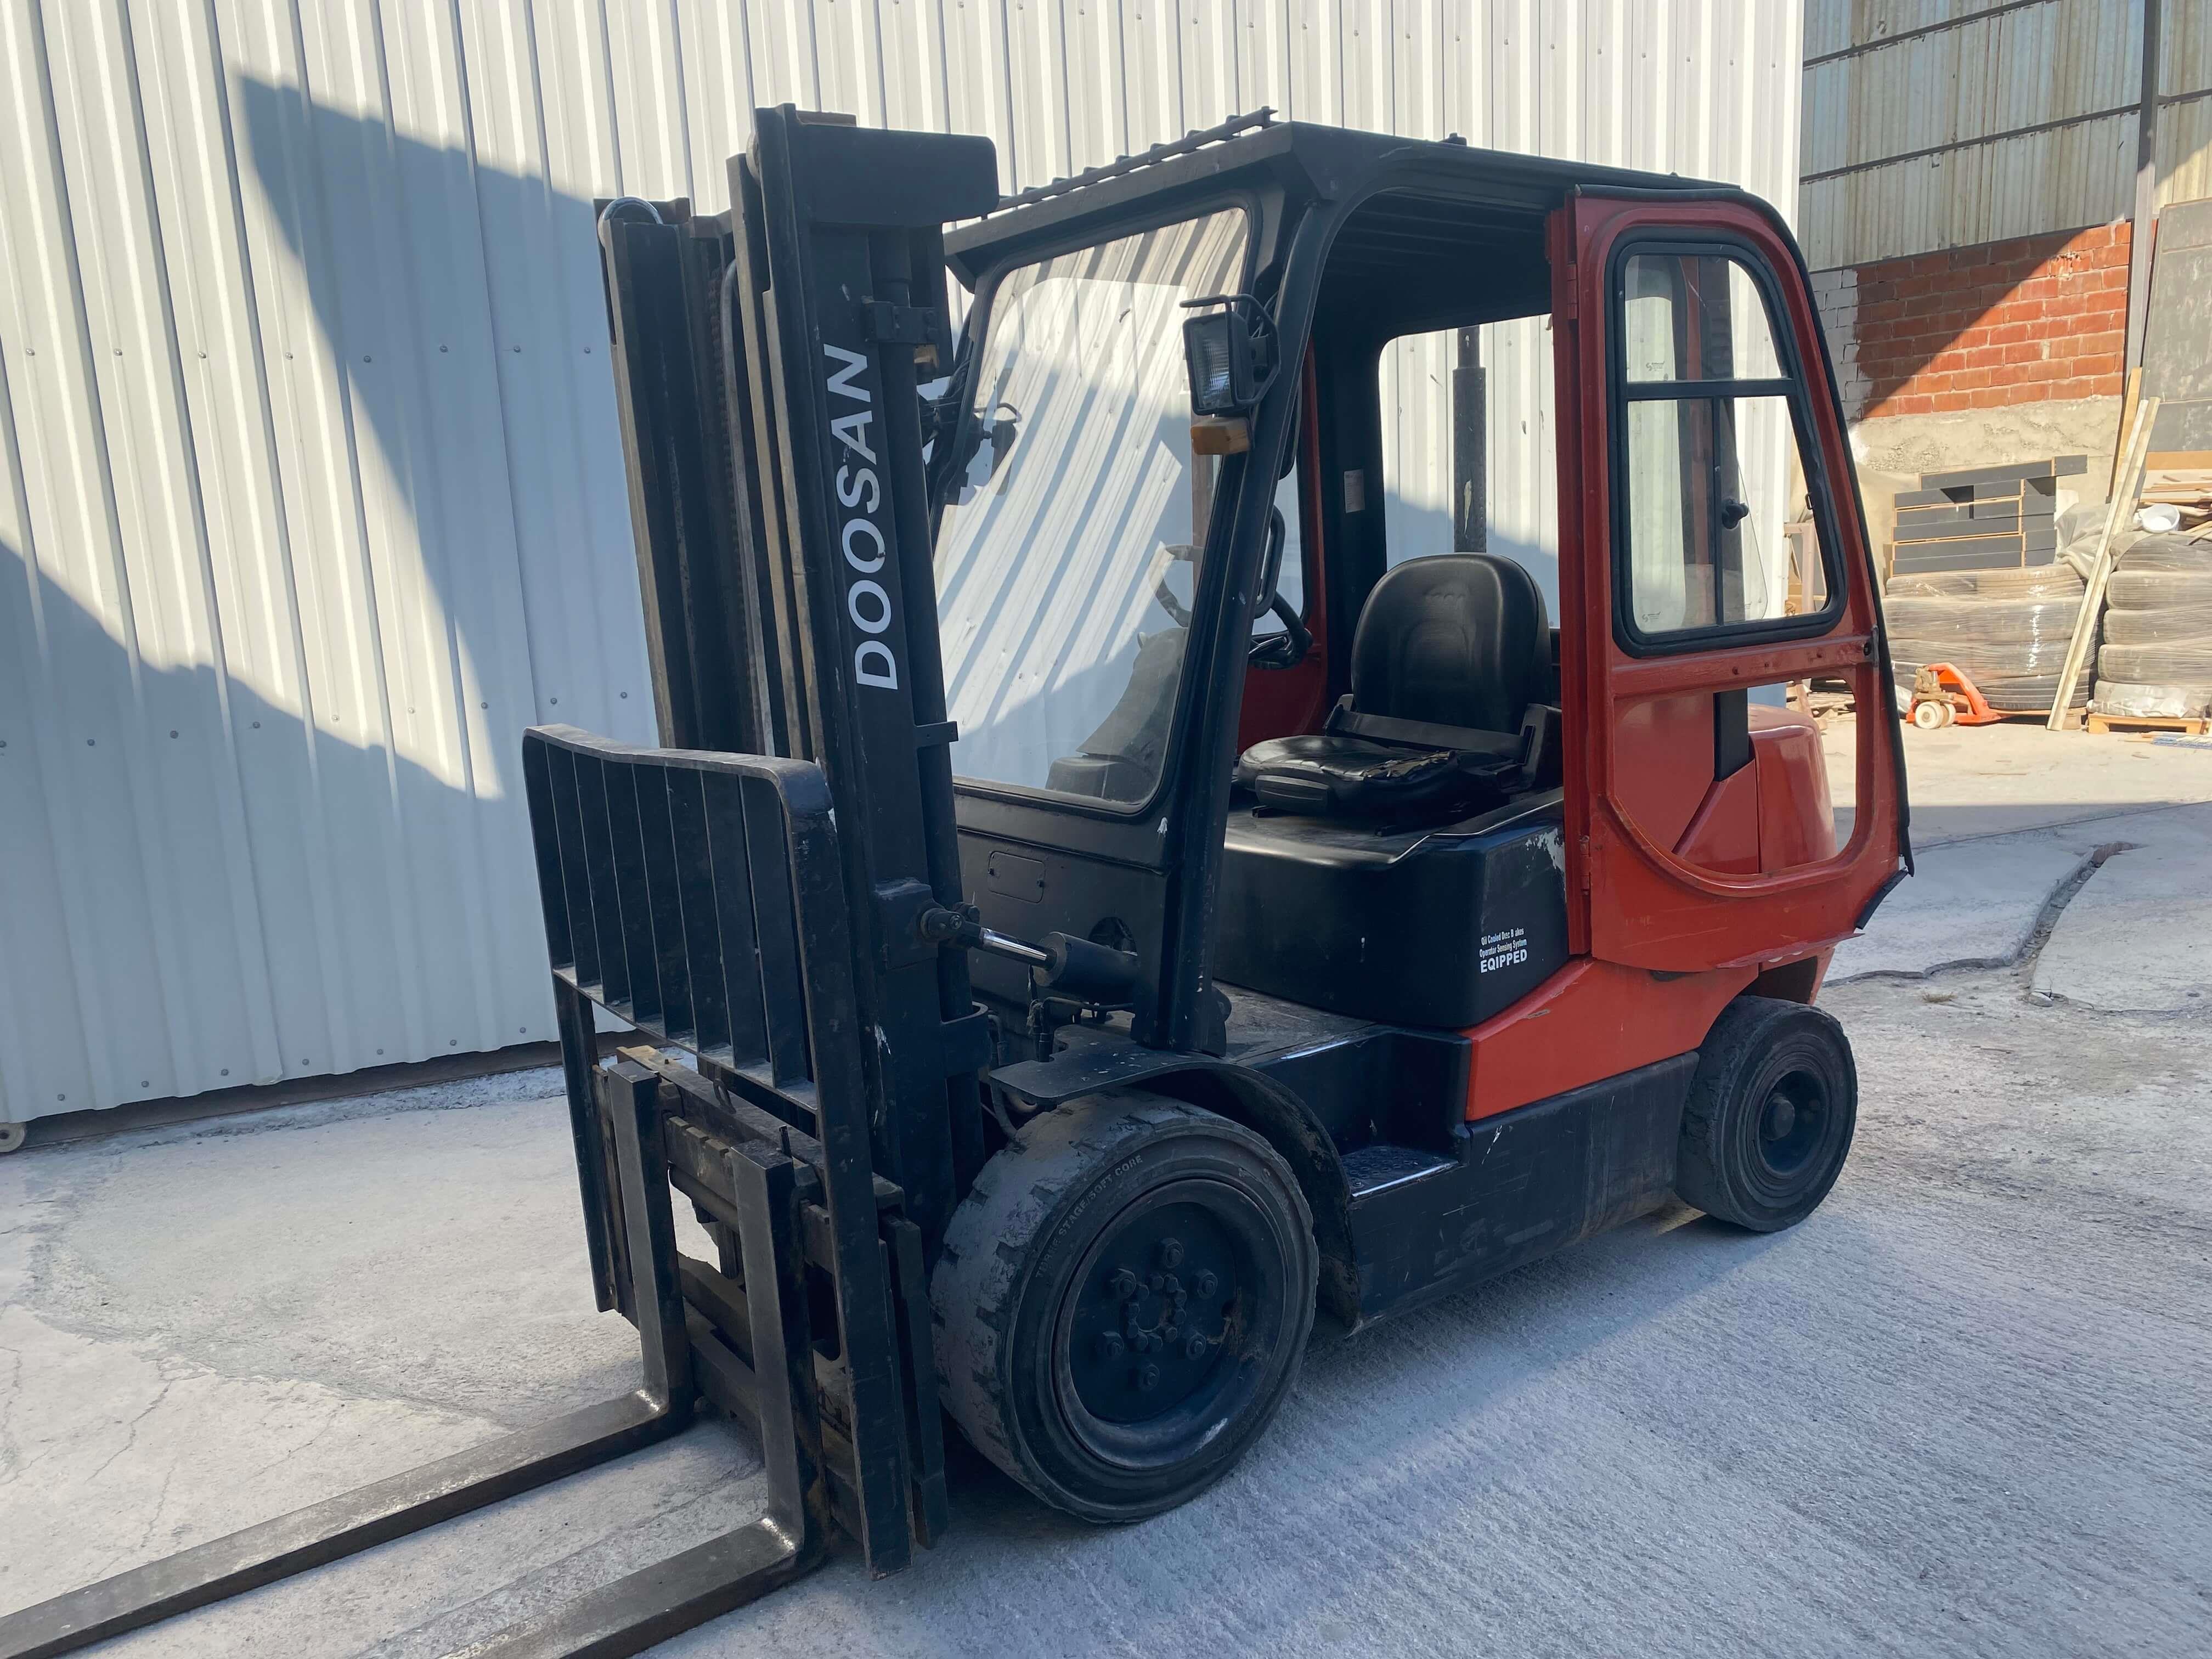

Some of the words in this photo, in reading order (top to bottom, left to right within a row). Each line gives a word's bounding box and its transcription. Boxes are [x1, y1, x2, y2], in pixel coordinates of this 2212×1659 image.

[823, 343, 898, 690] DOOSAN
[1487, 933, 1501, 944] Cooled
[1502, 932, 1510, 940] Disc
[1510, 928, 1524, 938] Bakes
[1479, 946, 1497, 958] Operator
[1497, 942, 1513, 953] Sensing
[1513, 939, 1527, 950] System
[1480, 949, 1527, 973] EQIPPED
[1114, 1154, 1143, 1177] CORE
